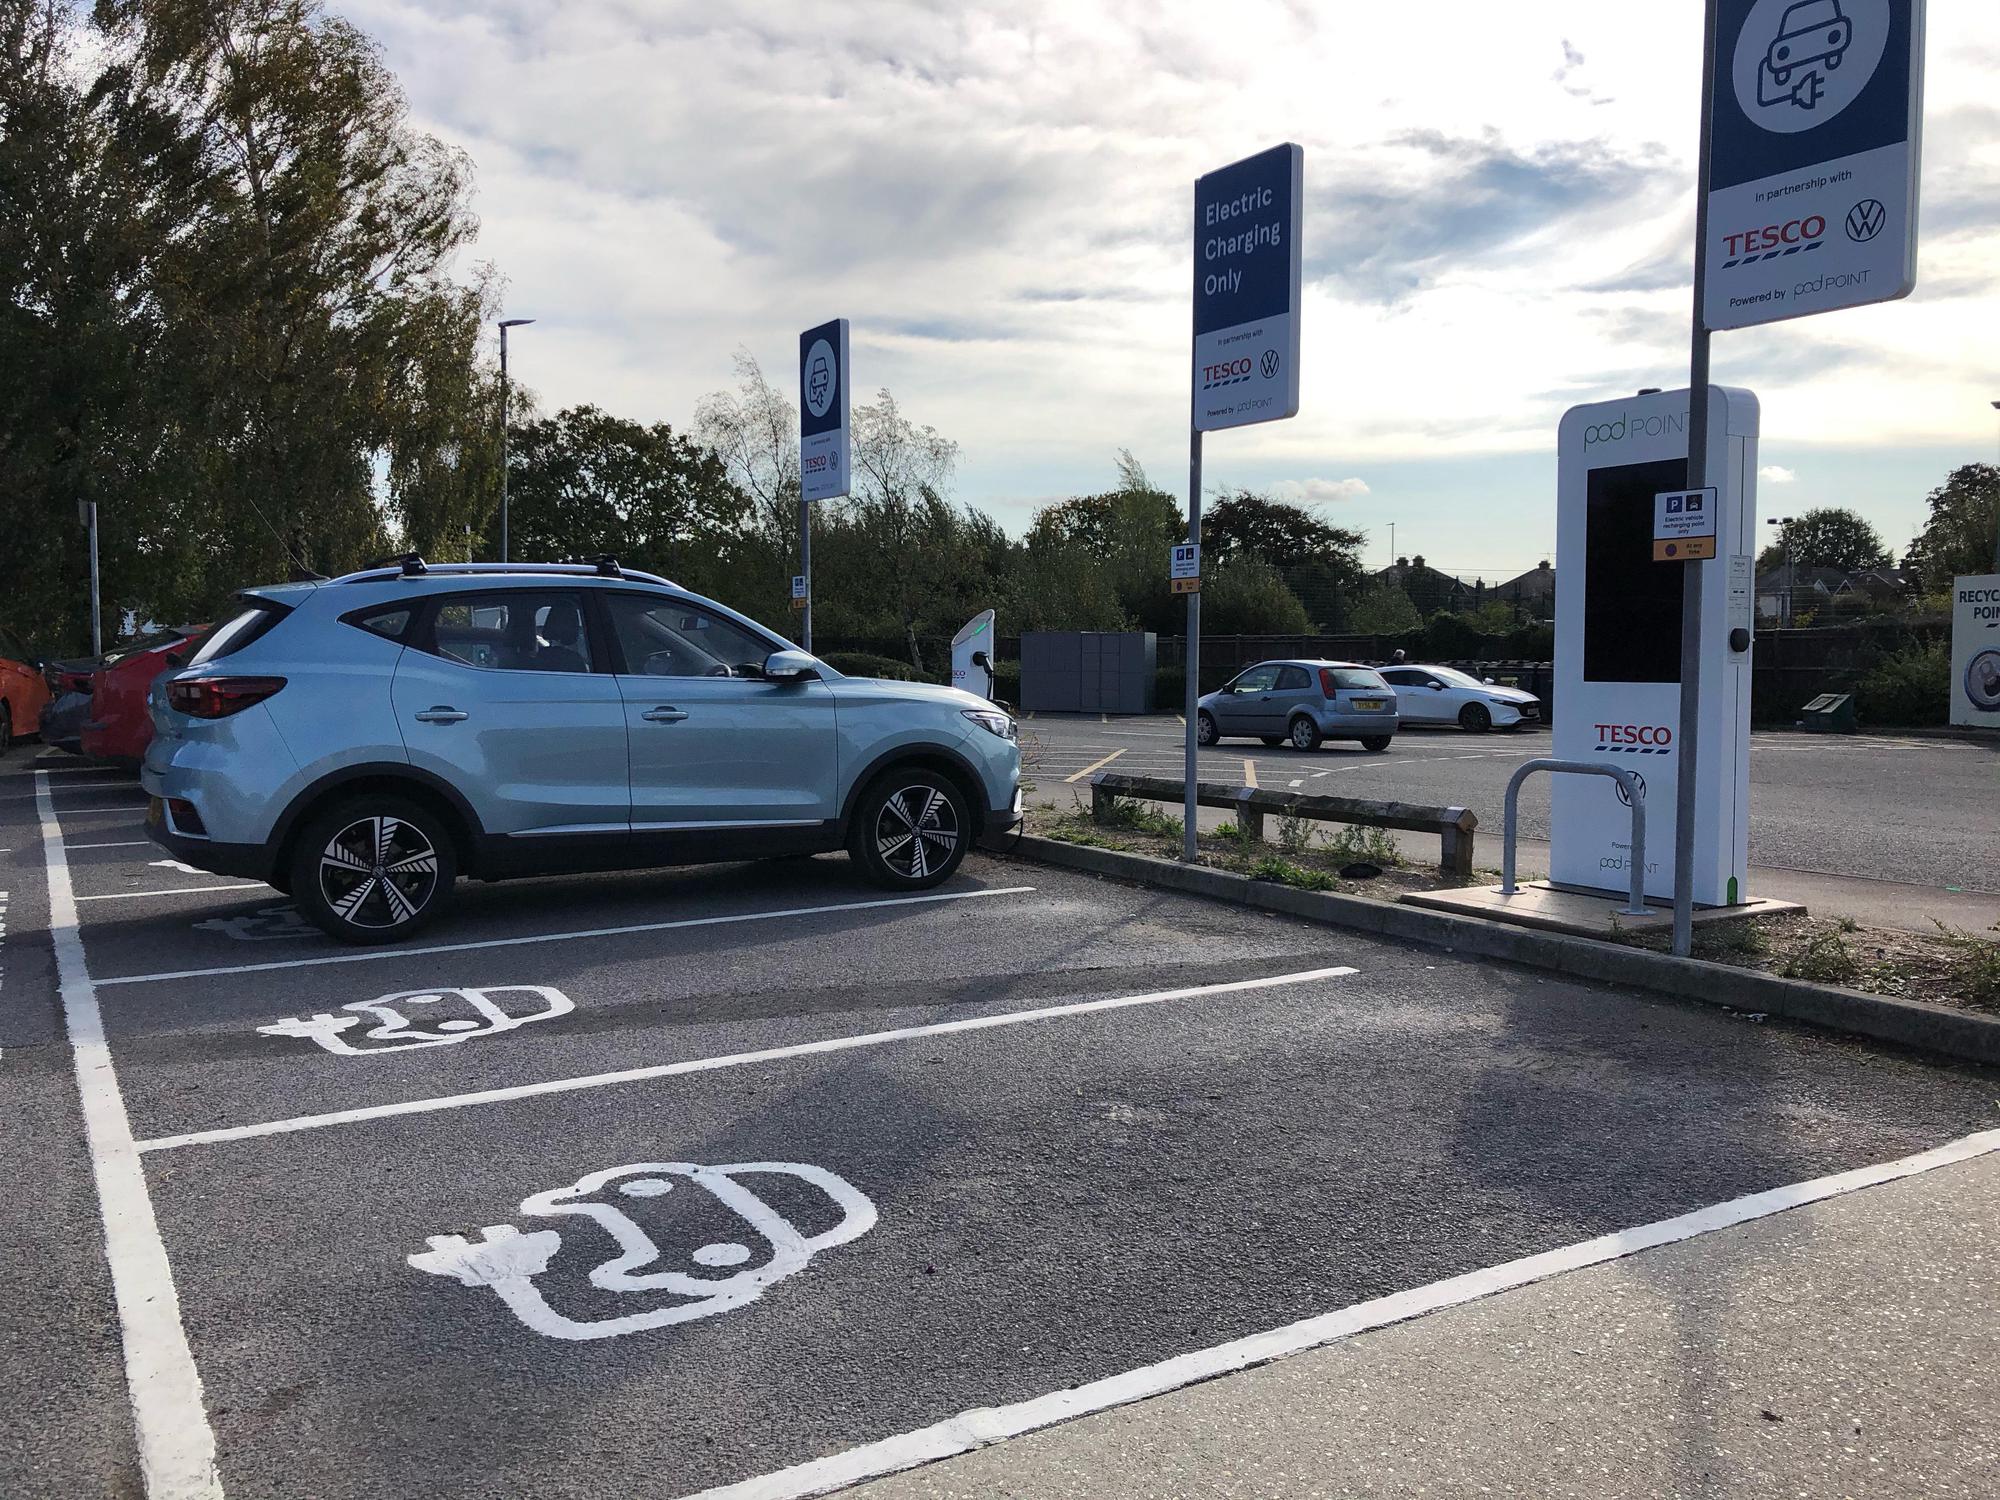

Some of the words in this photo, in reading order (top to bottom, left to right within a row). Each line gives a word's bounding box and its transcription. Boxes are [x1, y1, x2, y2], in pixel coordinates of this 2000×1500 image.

[1755, 191, 1765, 203] In
[1767, 177, 1827, 202] partnership
[1829, 170, 1852, 187] with
[1206, 186, 1273, 226] Electric
[1205, 221, 1281, 261] Charging
[1722, 215, 1826, 257] TESCO
[1205, 268, 1242, 296] Only
[1729, 290, 1773, 308] Powered
[1774, 286, 1786, 303] by
[1203, 358, 1252, 382] TESCO
[1207, 406, 1228, 417] Powered
[1228, 405, 1234, 415] by
[805, 455, 827, 469] TESCO
[1671, 500, 1679, 510] P
[1959, 589, 2000, 603] RECYC
[1594, 724, 1672, 746] TESCO
[1611, 841, 1632, 850] Power
[1623, 860, 1659, 874] PNT
